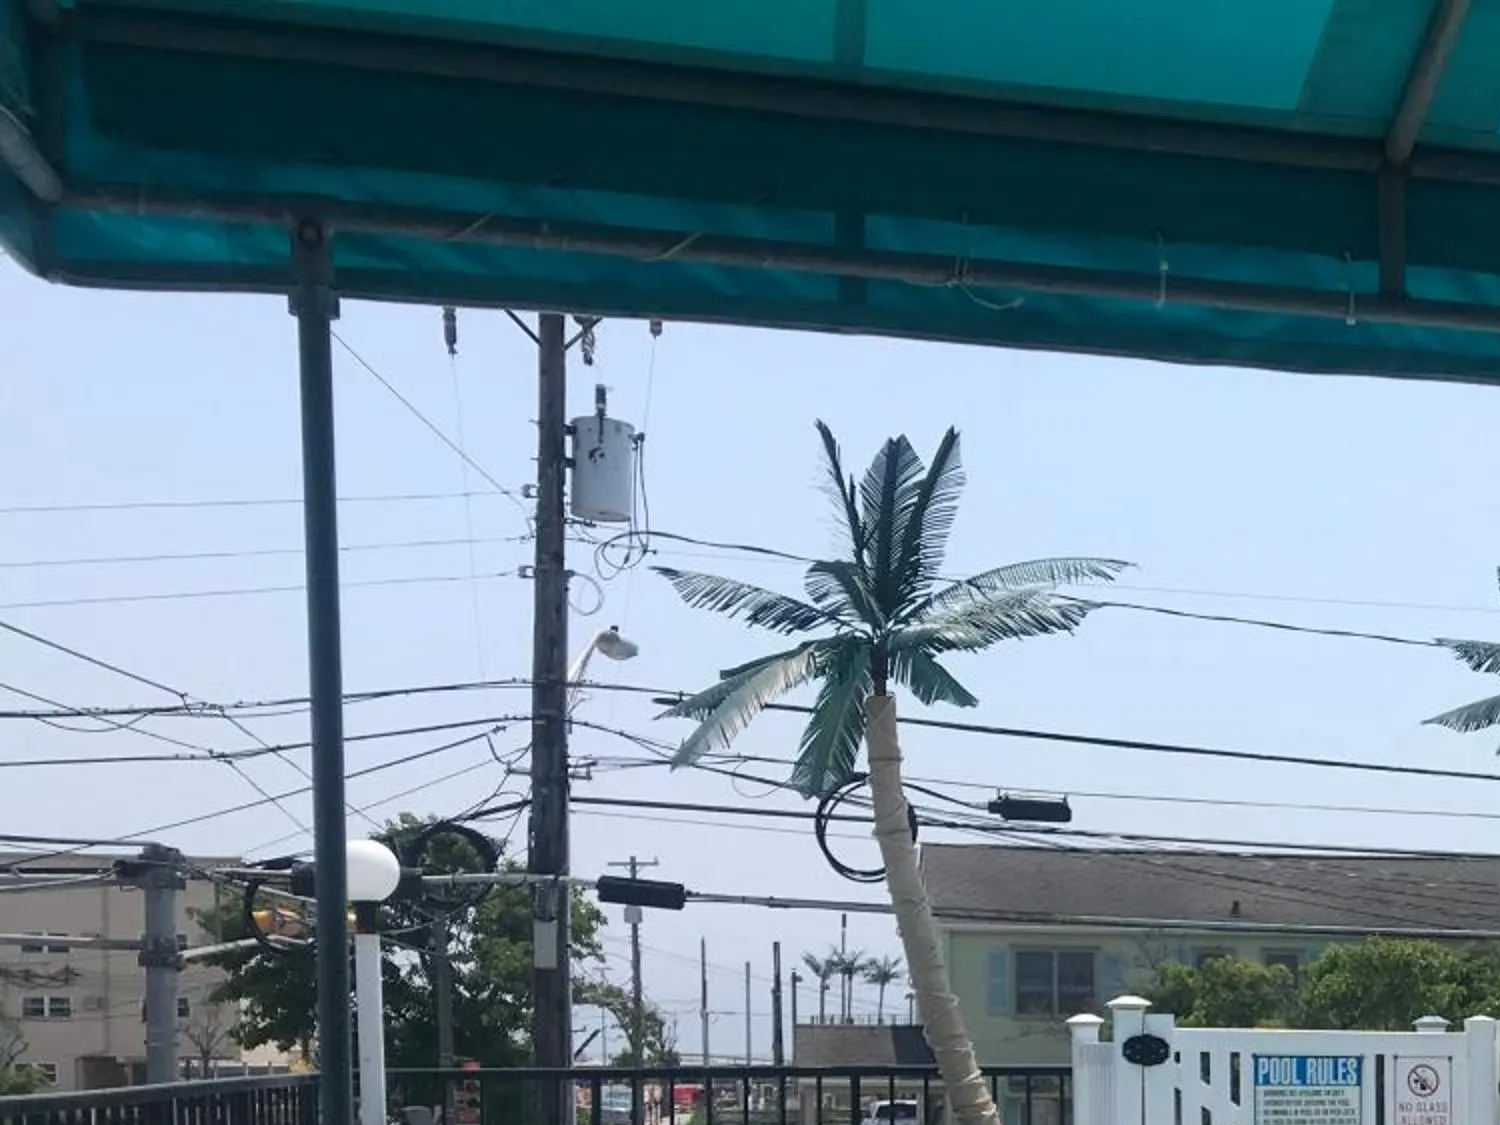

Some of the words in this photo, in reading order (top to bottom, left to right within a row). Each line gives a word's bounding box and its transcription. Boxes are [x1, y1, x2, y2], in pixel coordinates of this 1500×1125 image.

[1257, 1056, 1302, 1085] POOL
[1305, 1056, 1358, 1085] RULES
[1398, 1102, 1413, 1113] NO
[1416, 1101, 1448, 1113] GLASS
